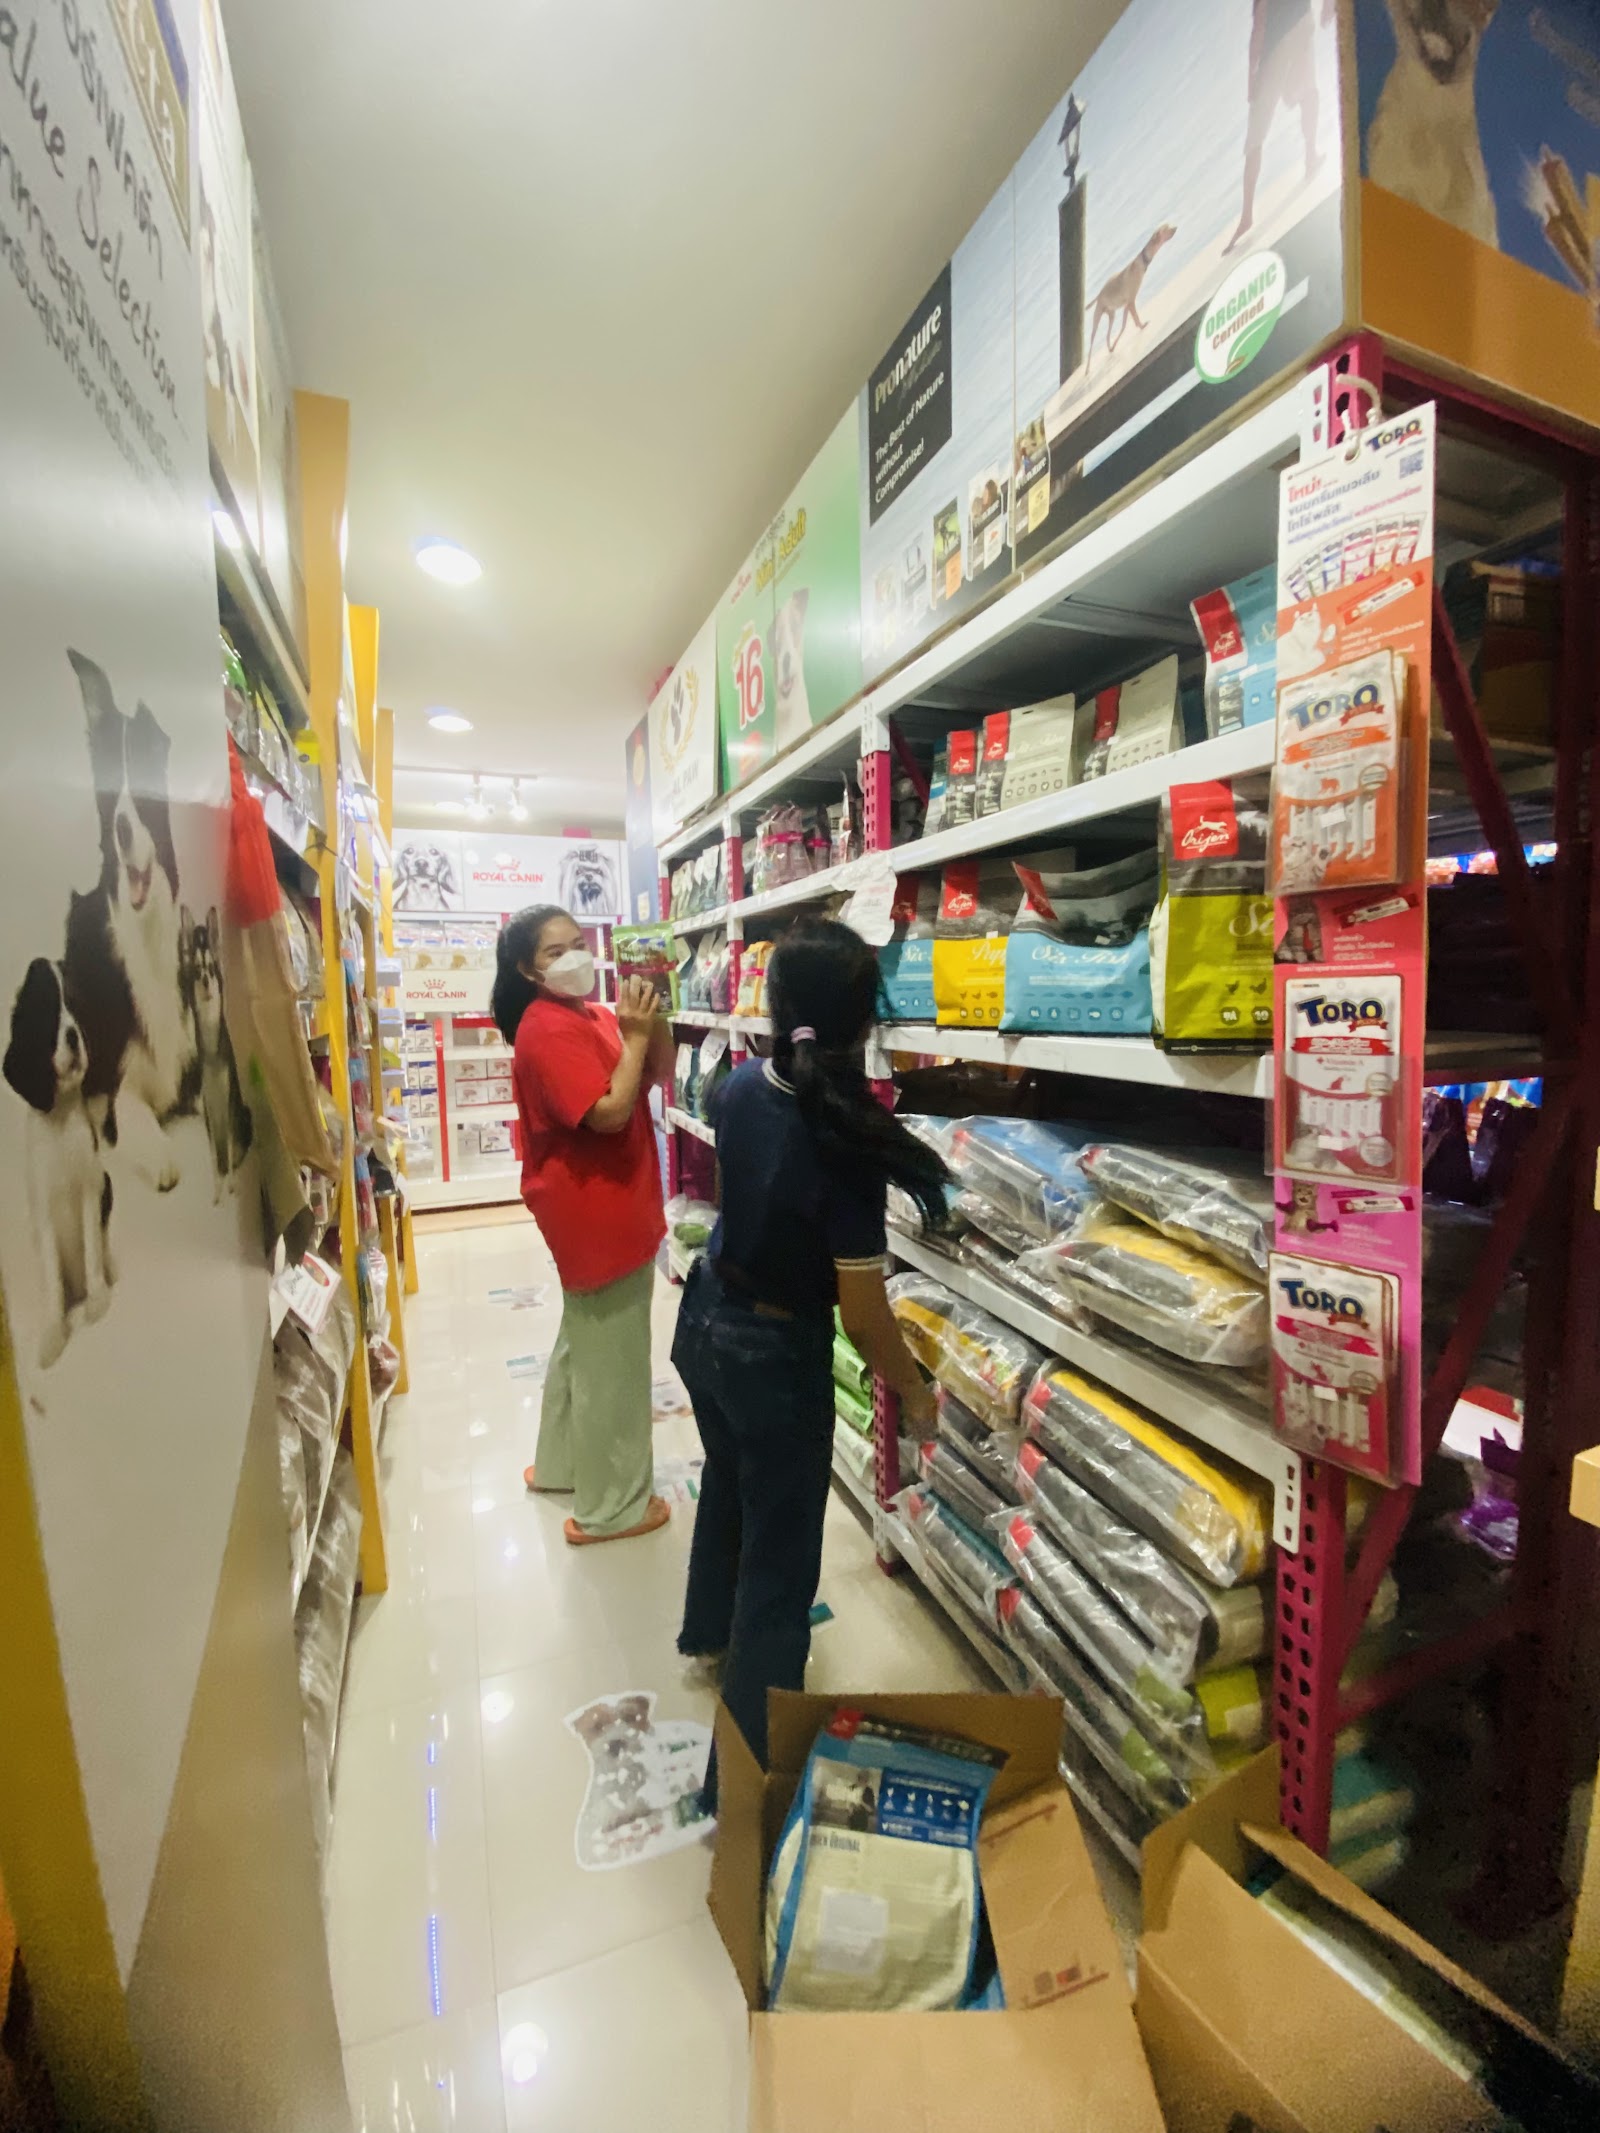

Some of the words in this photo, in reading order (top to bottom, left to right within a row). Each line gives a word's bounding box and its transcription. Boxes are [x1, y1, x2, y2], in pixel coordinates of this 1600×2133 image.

[76, 156, 178, 420] Selection
[1205, 262, 1277, 340] ORGANIC
[1212, 298, 1266, 350] Certified
[874, 304, 943, 414] Pronature
[875, 441, 889, 464] The
[889, 421, 906, 448] Best
[906, 406, 915, 427] of
[914, 370, 946, 416] Nature
[1365, 418, 1422, 452] TORO
[875, 443, 904, 484] without
[875, 436, 925, 504] Compromise!
[779, 507, 807, 561] Adult
[736, 634, 765, 728] 16
[1288, 682, 1380, 731] TORO
[1181, 827, 1230, 853] Orijen
[472, 872, 507, 882] ROYAL
[508, 872, 544, 883] CANIN
[1031, 944, 1068, 965] Six
[405, 991, 436, 999] ROYAL
[436, 991, 467, 999] CANIN
[1297, 995, 1384, 1027] TORO
[1279, 1279, 1365, 1319] TORO
